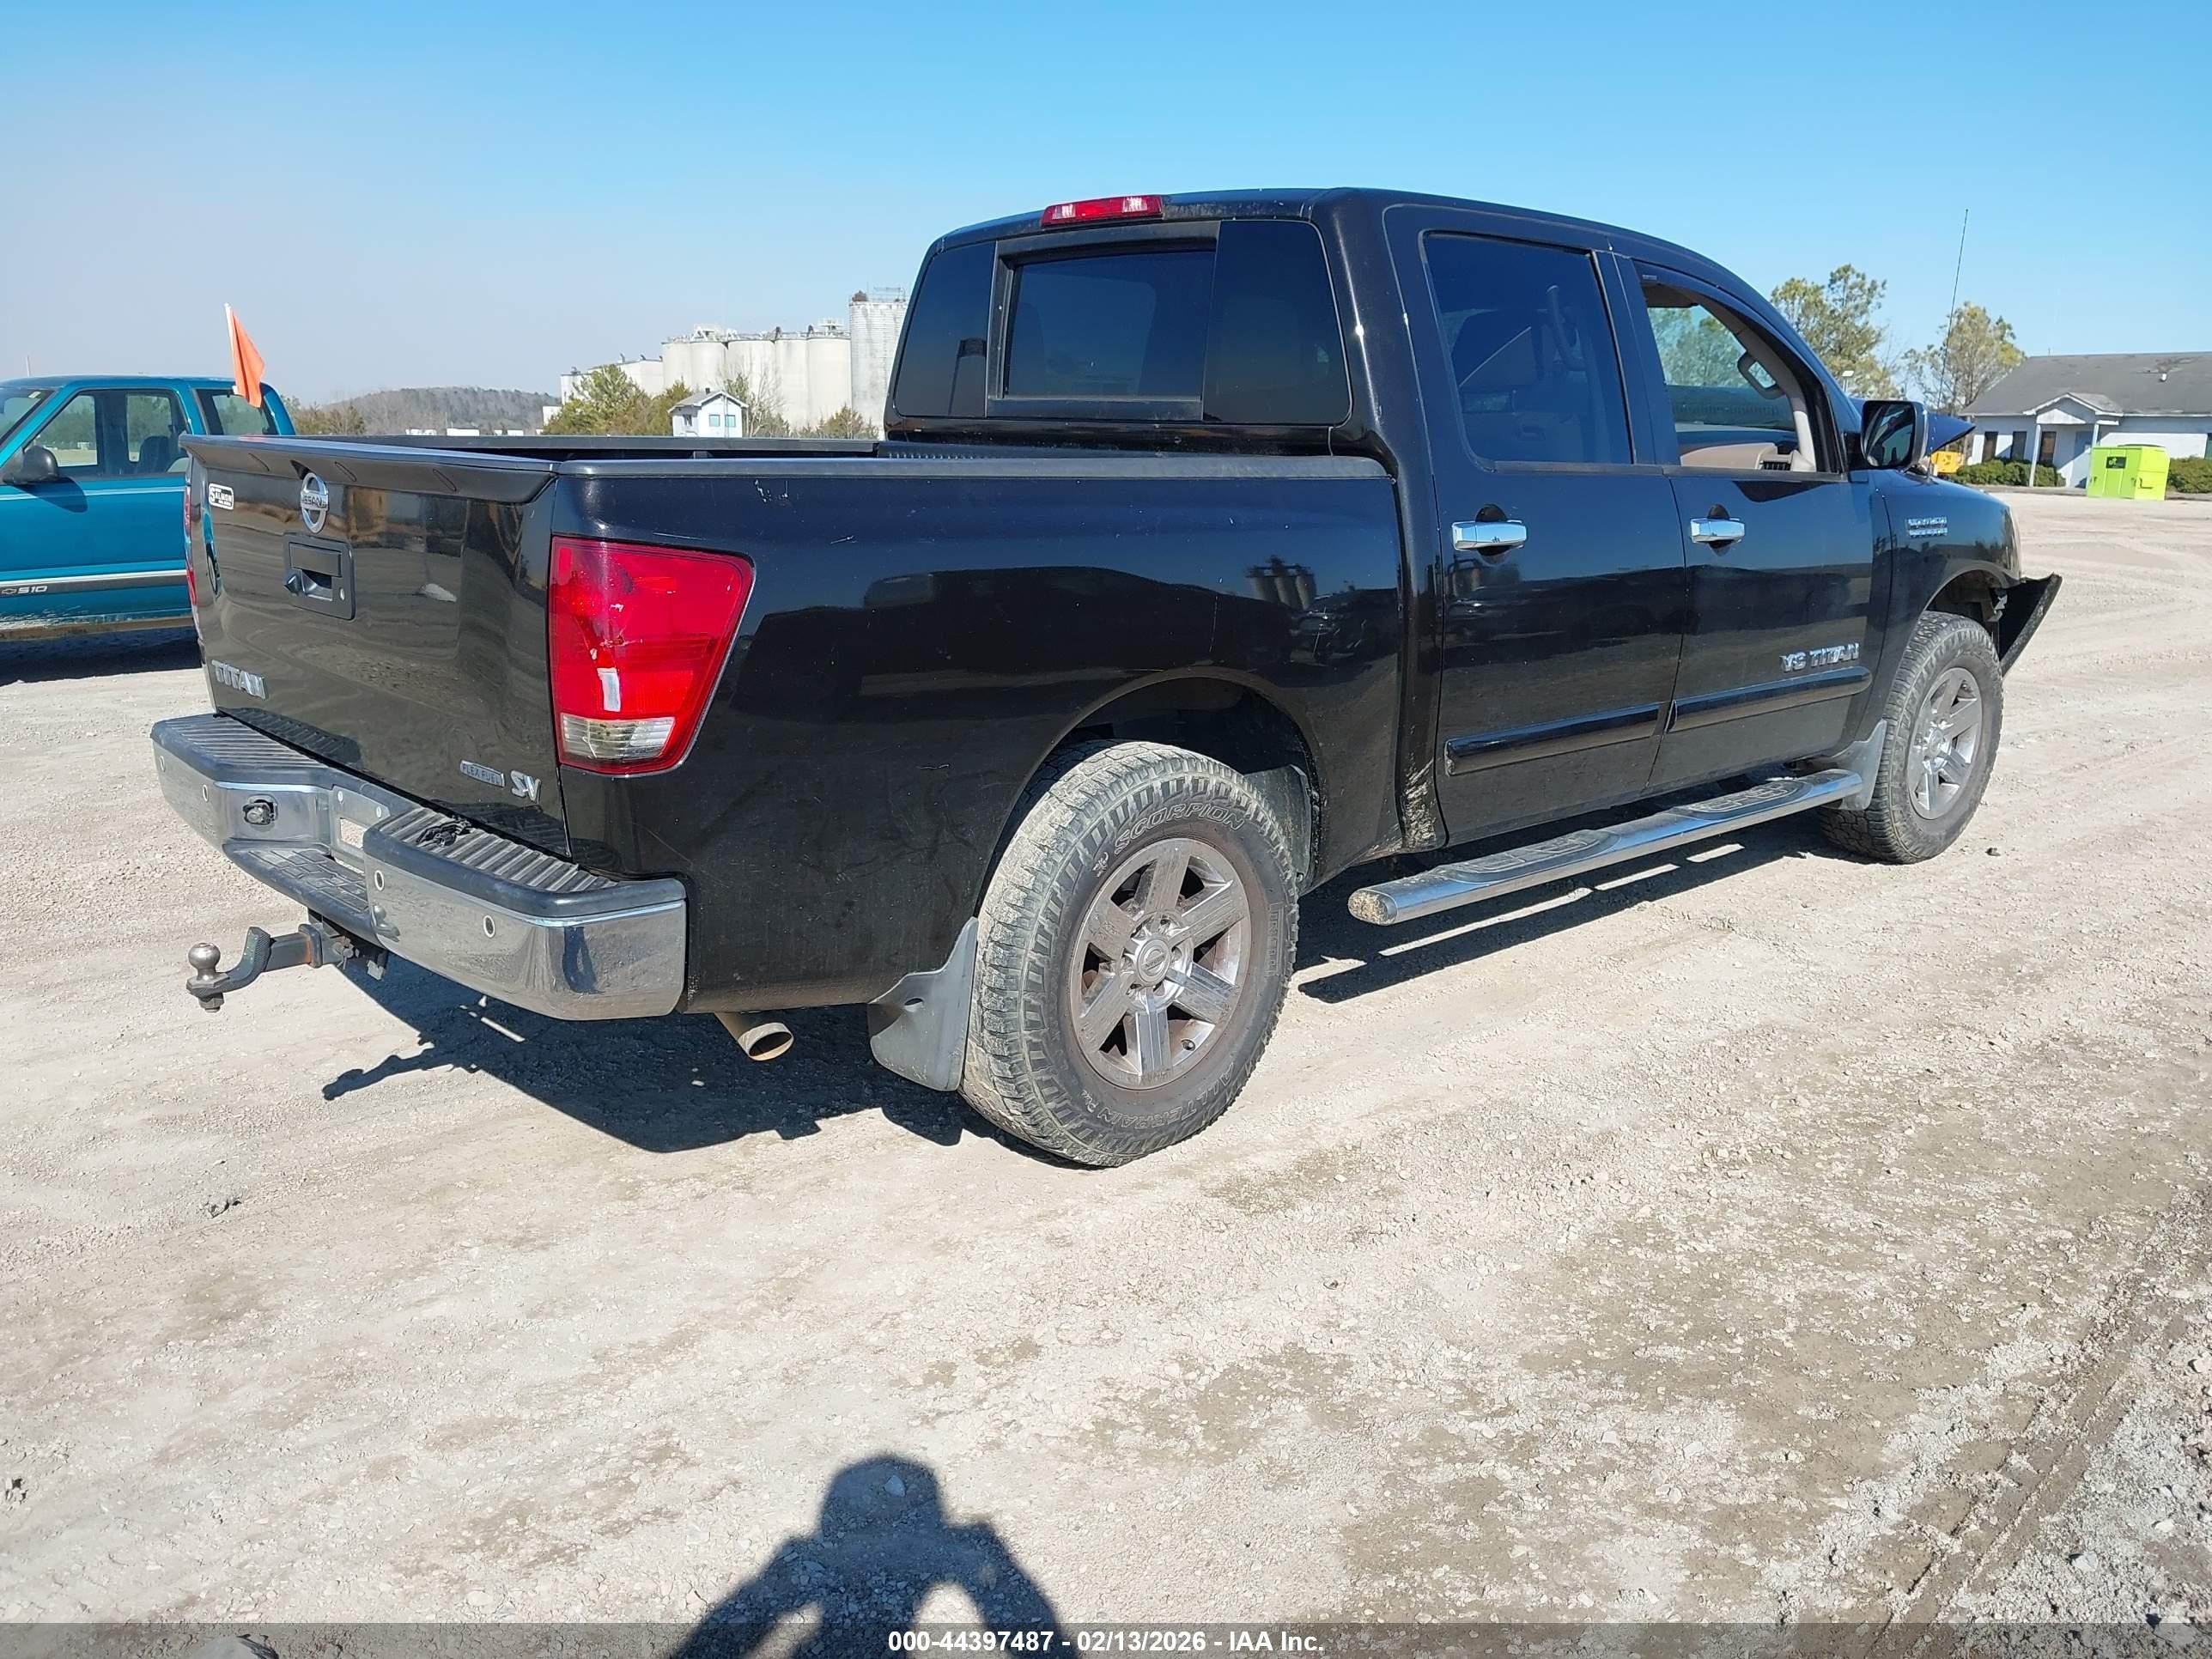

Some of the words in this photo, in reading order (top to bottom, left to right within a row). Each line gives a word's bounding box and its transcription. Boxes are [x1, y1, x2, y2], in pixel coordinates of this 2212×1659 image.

[17, 585, 48, 594] S10
[1808, 642, 1860, 667] TITAN
[211, 659, 266, 700] TITAN
[462, 763, 480, 779] FLEX
[481, 769, 501, 785] FUEL
[510, 769, 542, 803] SV
[1114, 802, 1246, 855] SCORPION
[1196, 1061, 1234, 1105] ALL
[1097, 1100, 1198, 1130] TERRAIN
